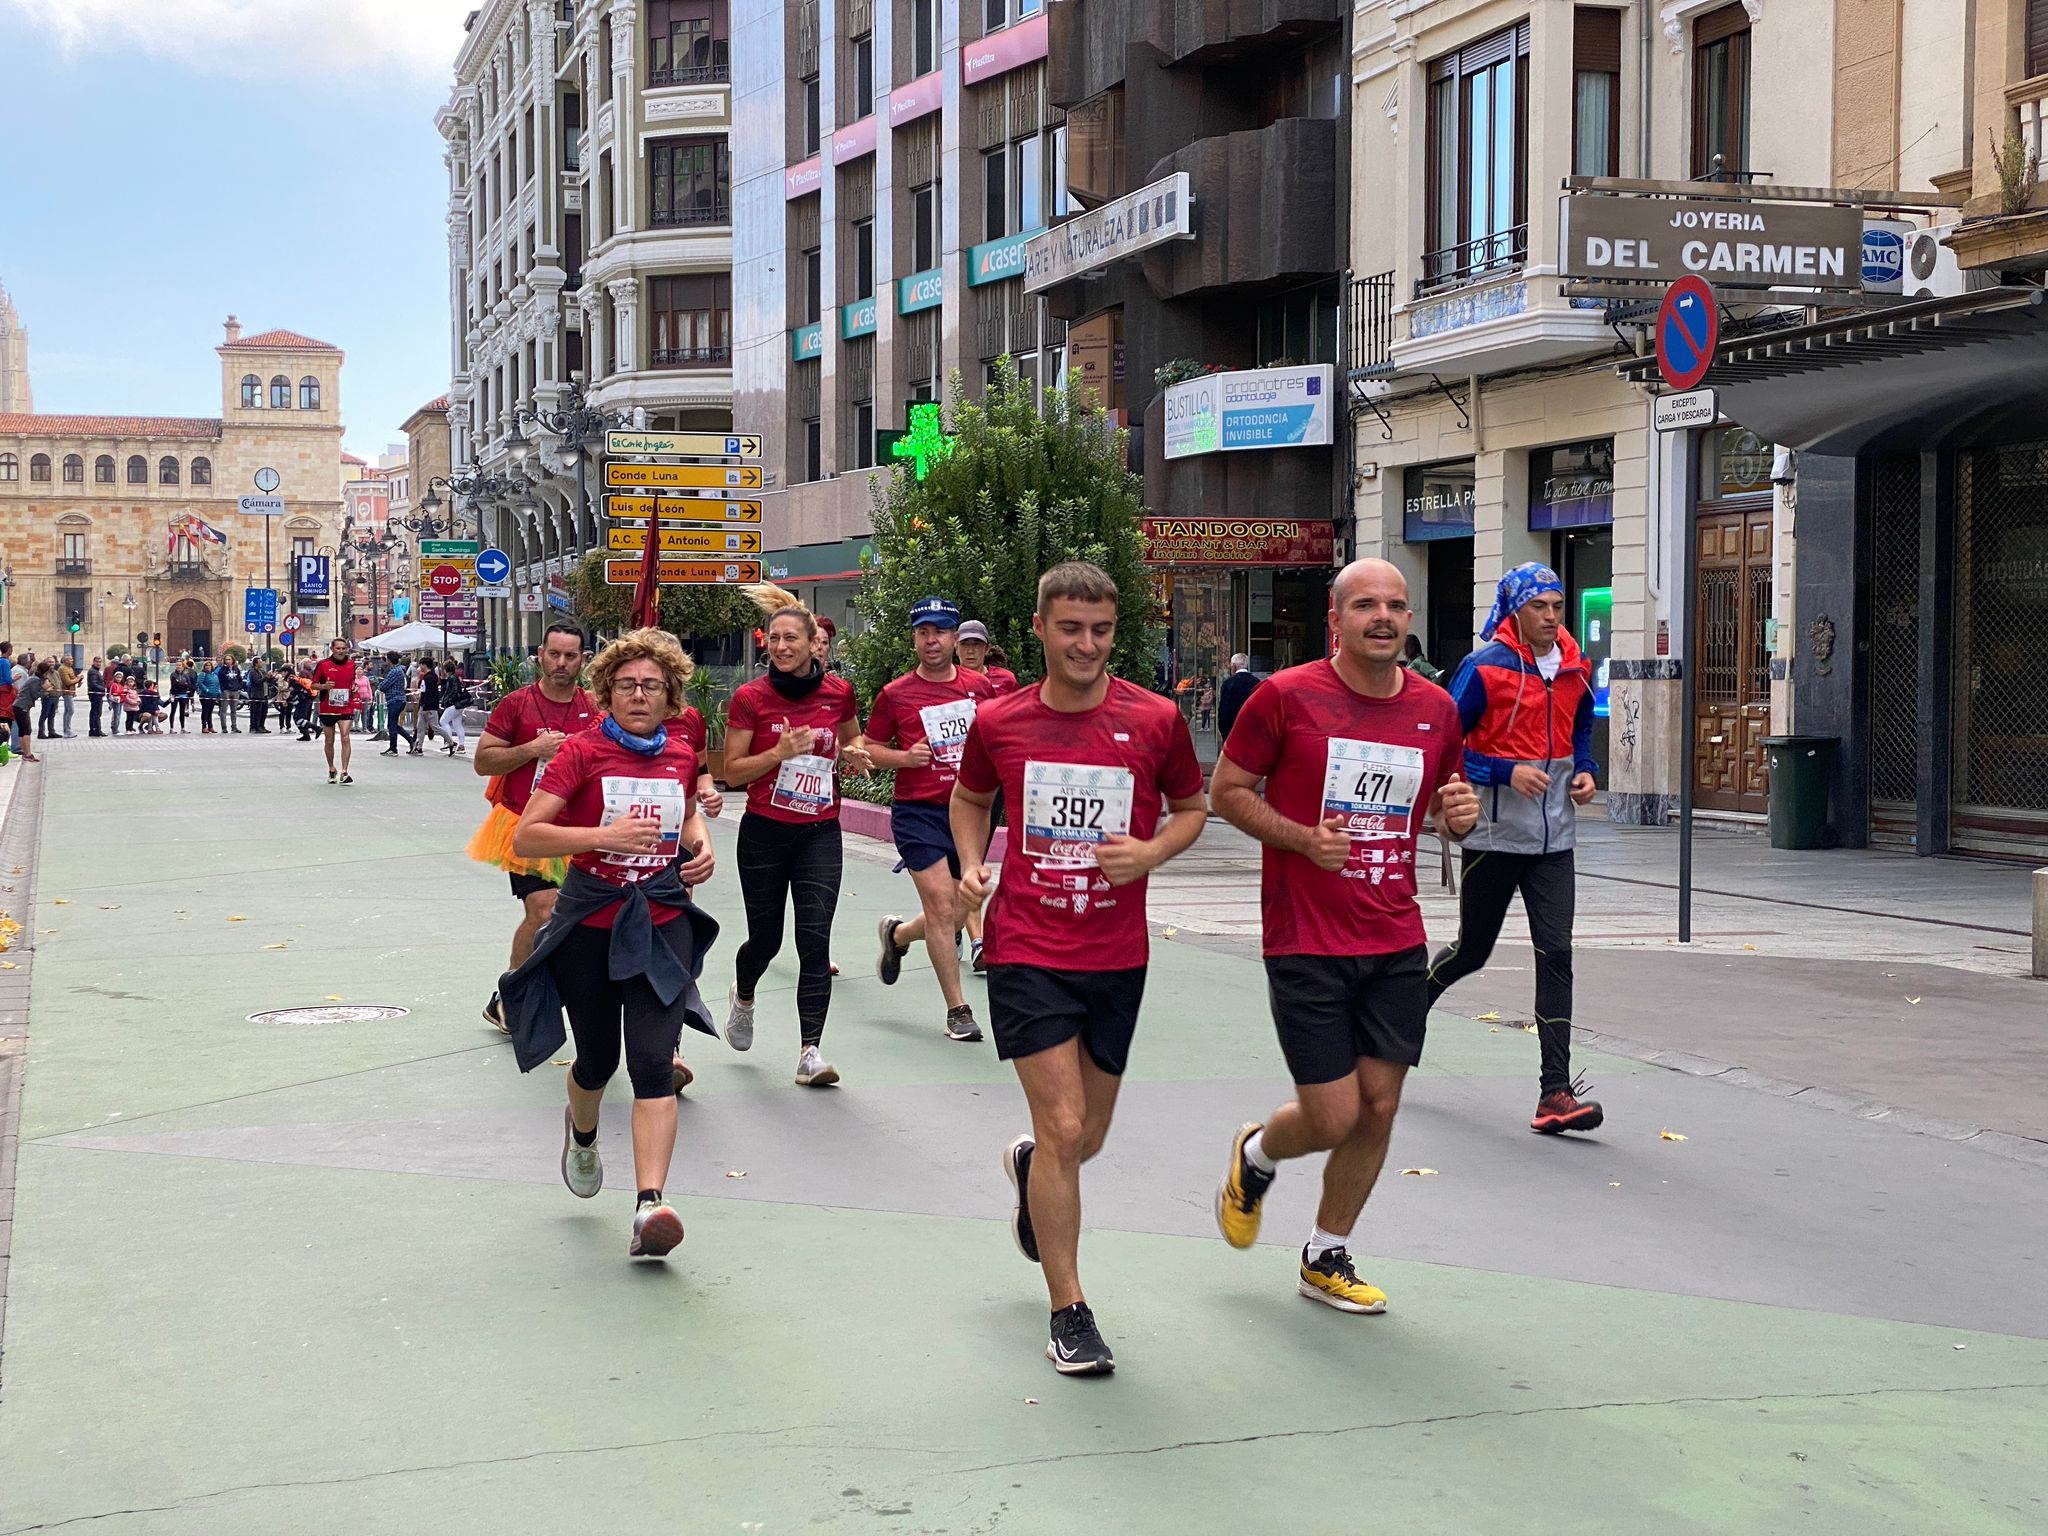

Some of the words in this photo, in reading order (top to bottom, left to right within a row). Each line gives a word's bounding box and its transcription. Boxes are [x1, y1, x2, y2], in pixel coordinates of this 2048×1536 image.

[1670, 211, 1765, 231] JOYERIA
[1060, 216, 1124, 266] NATURALEZA
[1586, 236, 1659, 269] DEL
[1681, 240, 1844, 276] CARMEN
[1861, 249, 1897, 265] AMC
[1225, 377, 1304, 394] ordoñotres
[1167, 390, 1210, 421] BUSTILLO
[1672, 397, 1697, 408] EXCEPTO
[1226, 413, 1288, 427] ORTODONCIA
[1657, 413, 1676, 424] CARGA
[1677, 411, 1681, 419] Y
[1681, 408, 1712, 420] DESCARGA
[1226, 429, 1273, 441] INVISIBLE
[611, 470, 647, 481] Conde
[652, 471, 679, 481] Luna
[611, 501, 633, 512] Luis
[640, 503, 653, 513] de
[658, 503, 685, 514] León
[1406, 493, 1461, 512] ESTRELLA
[1152, 520, 1299, 538] TANDOORI
[611, 535, 634, 544] A.C.
[668, 535, 710, 546] Antonio
[1143, 540, 1220, 550] STAURANT
[1223, 540, 1233, 550] &
[1236, 540, 1269, 550] BAR
[1154, 550, 1198, 559] Indian
[1204, 551, 1253, 560] Cusine
[611, 566, 640, 577] casin
[660, 565, 686, 577] onde
[691, 567, 717, 577] Luna
[770, 565, 788, 578] Unicaja
[433, 576, 459, 584] STOP
[939, 717, 968, 739] 528
[794, 771, 821, 795] 700
[1354, 772, 1394, 803] 471
[1051, 796, 1105, 830] 392
